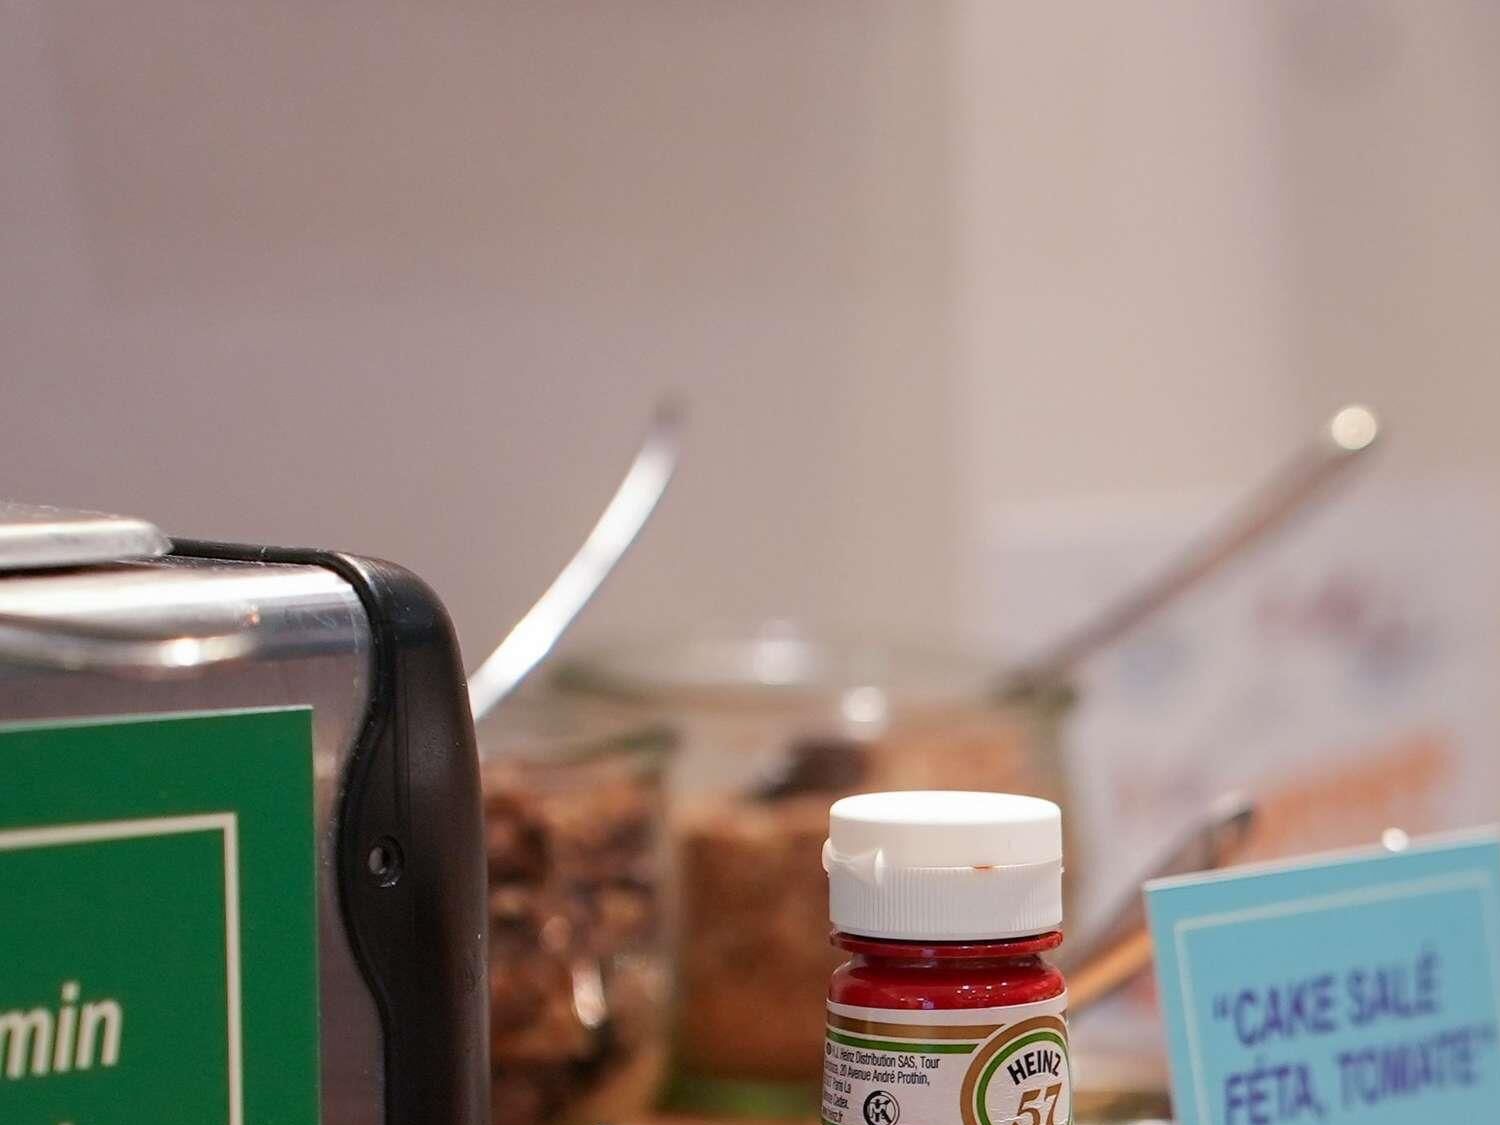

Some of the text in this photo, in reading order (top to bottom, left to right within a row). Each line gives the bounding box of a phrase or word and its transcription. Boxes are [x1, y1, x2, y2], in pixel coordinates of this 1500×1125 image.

[1346, 944, 1441, 1027] SALÉ
[855, 1051, 896, 1068] Distribution
[897, 1055, 918, 1070] SAS,
[920, 1056, 941, 1069] Tour
[1007, 1049, 1061, 1086] HEINZ
[847, 1065, 872, 1082] Avenue
[872, 1069, 896, 1084] André
[897, 1070, 930, 1086] Prothin,
